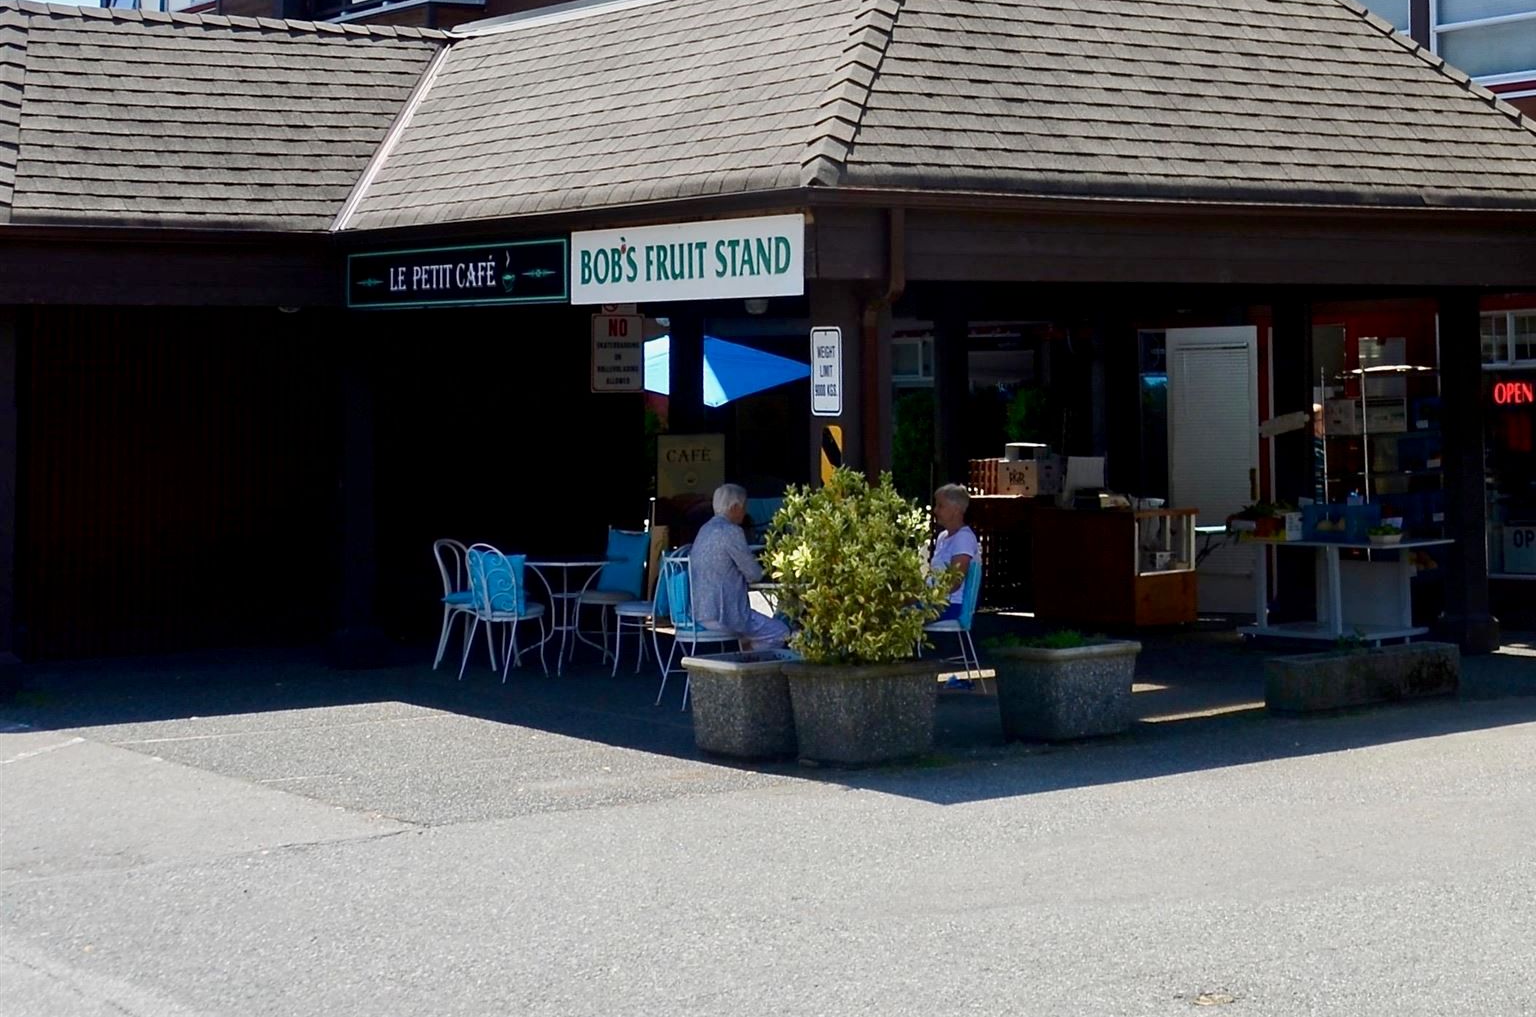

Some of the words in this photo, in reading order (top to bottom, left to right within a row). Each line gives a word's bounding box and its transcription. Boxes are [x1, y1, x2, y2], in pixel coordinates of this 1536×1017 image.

[580, 236, 638, 285] BOB'S
[645, 241, 707, 282] FRUIT
[715, 236, 791, 278] STAND
[389, 267, 407, 291] LE
[412, 264, 452, 290] PETIT
[455, 255, 496, 288] CAFÉ
[608, 318, 628, 337] NO
[817, 345, 836, 359] WEIGHT
[819, 365, 833, 378] LIMIT
[1494, 382, 1533, 404] OPEN
